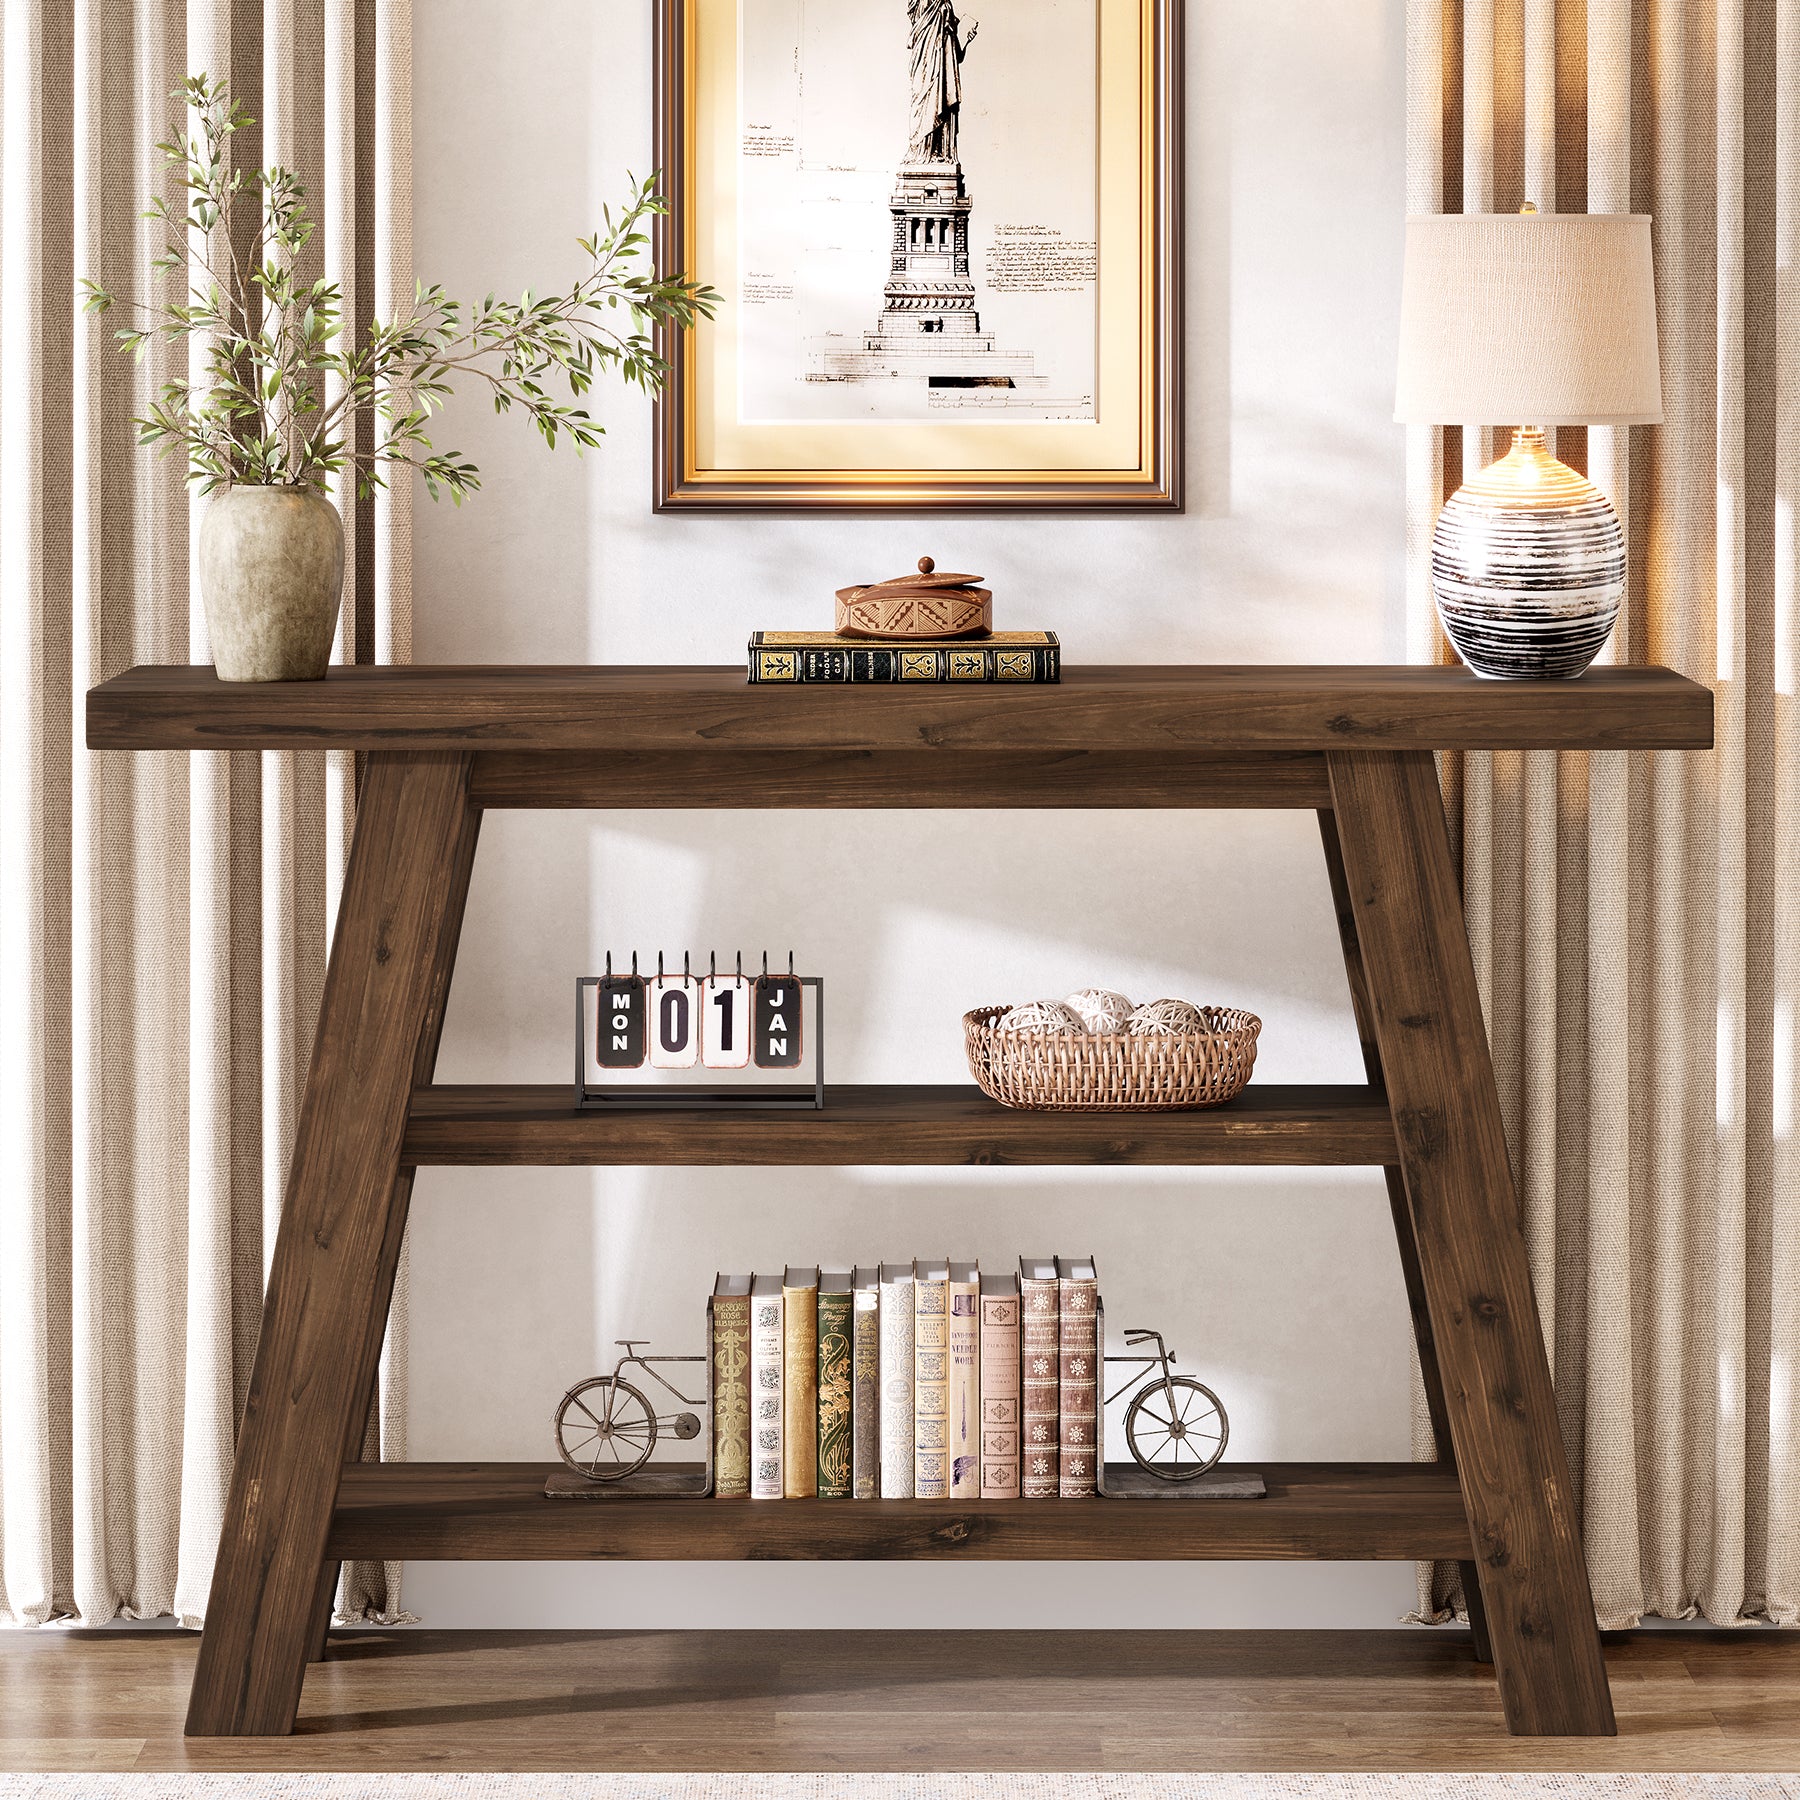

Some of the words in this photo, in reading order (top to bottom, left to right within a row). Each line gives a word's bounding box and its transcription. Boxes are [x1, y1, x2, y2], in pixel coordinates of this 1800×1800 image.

[612, 993, 631, 1051] MON
[768, 989, 788, 1056] JAN
[952, 1344, 977, 1353] NEEDLE
[954, 1356, 974, 1364] WORK
